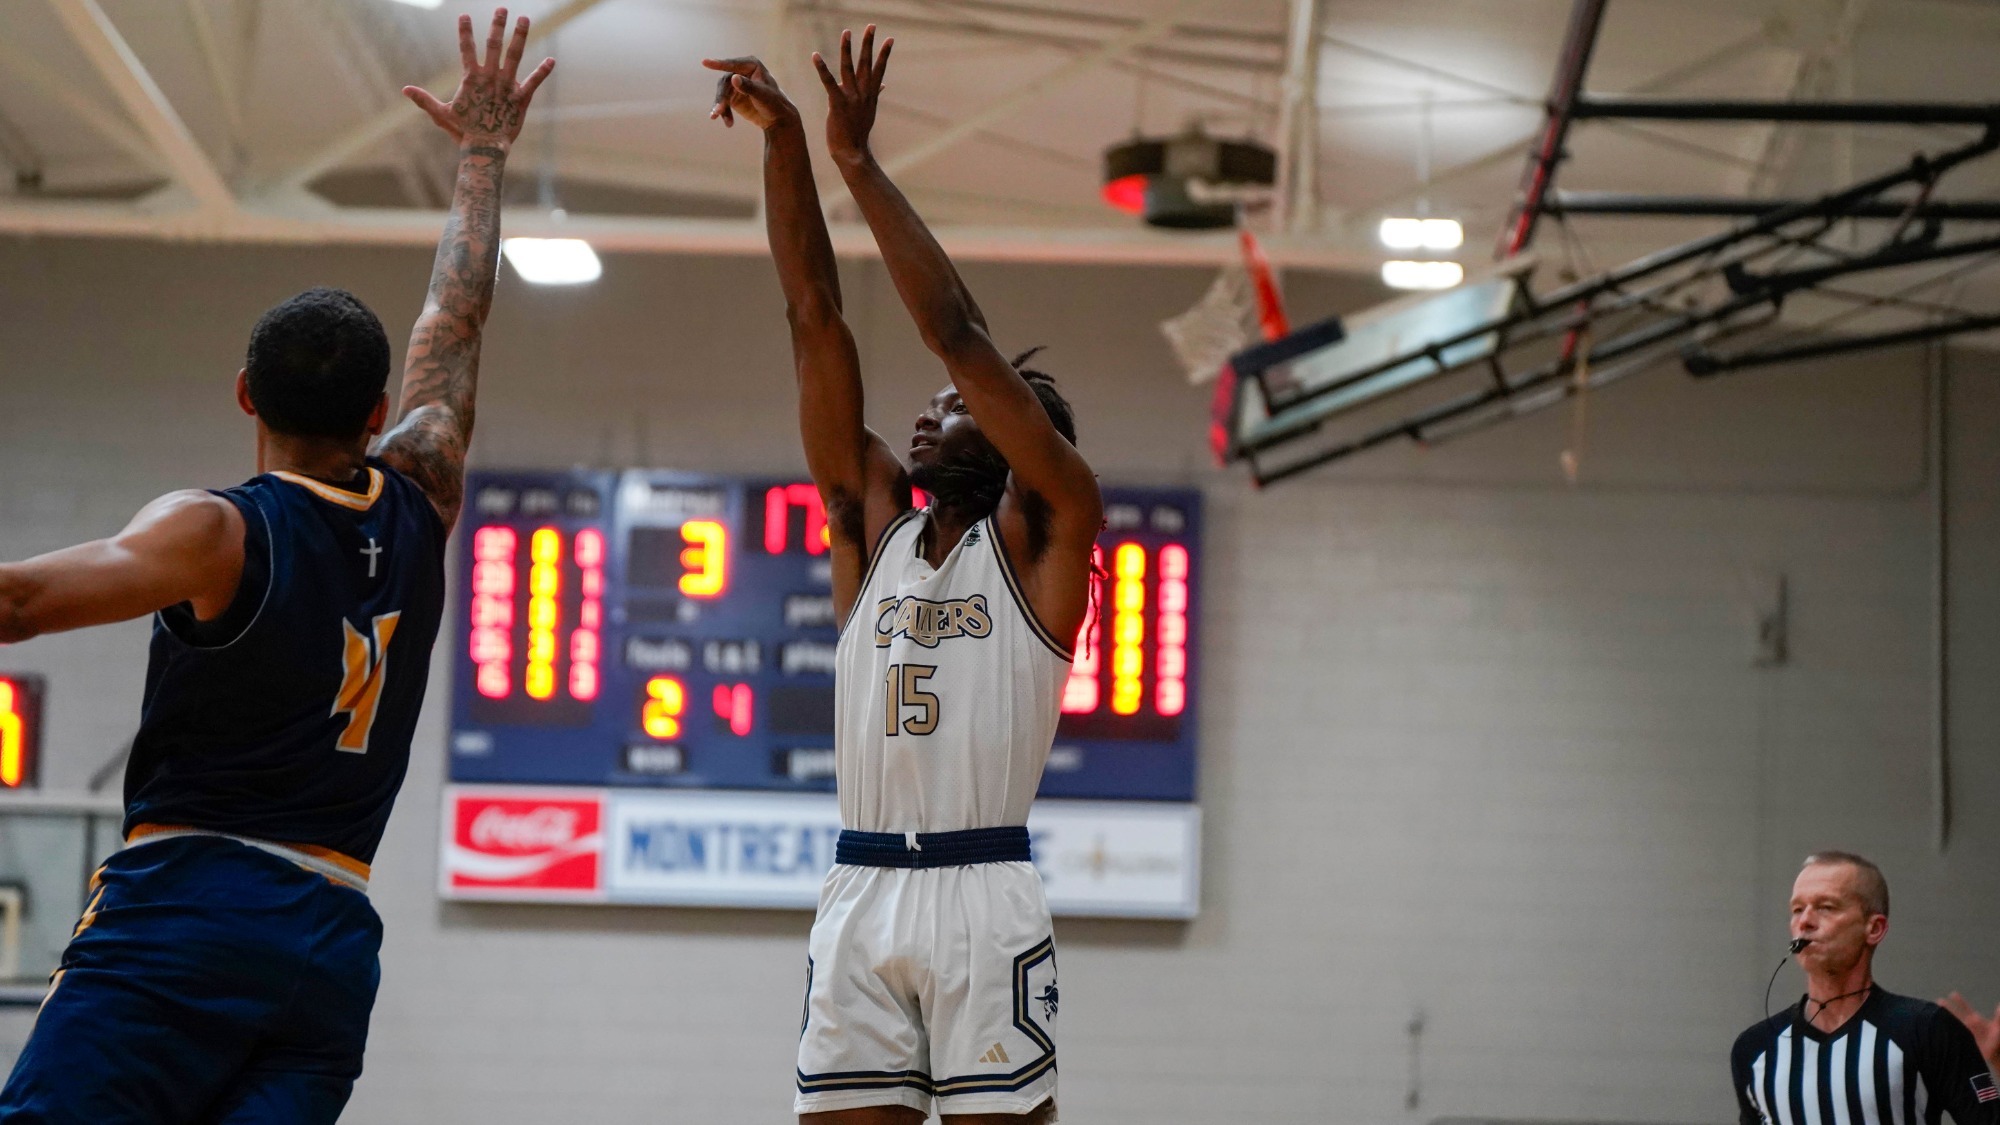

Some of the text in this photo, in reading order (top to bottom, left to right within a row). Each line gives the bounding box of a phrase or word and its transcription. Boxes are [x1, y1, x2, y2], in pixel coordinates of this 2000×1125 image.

[678, 519, 727, 597] 3
[642, 674, 687, 741] 2
[885, 663, 941, 737] 15
